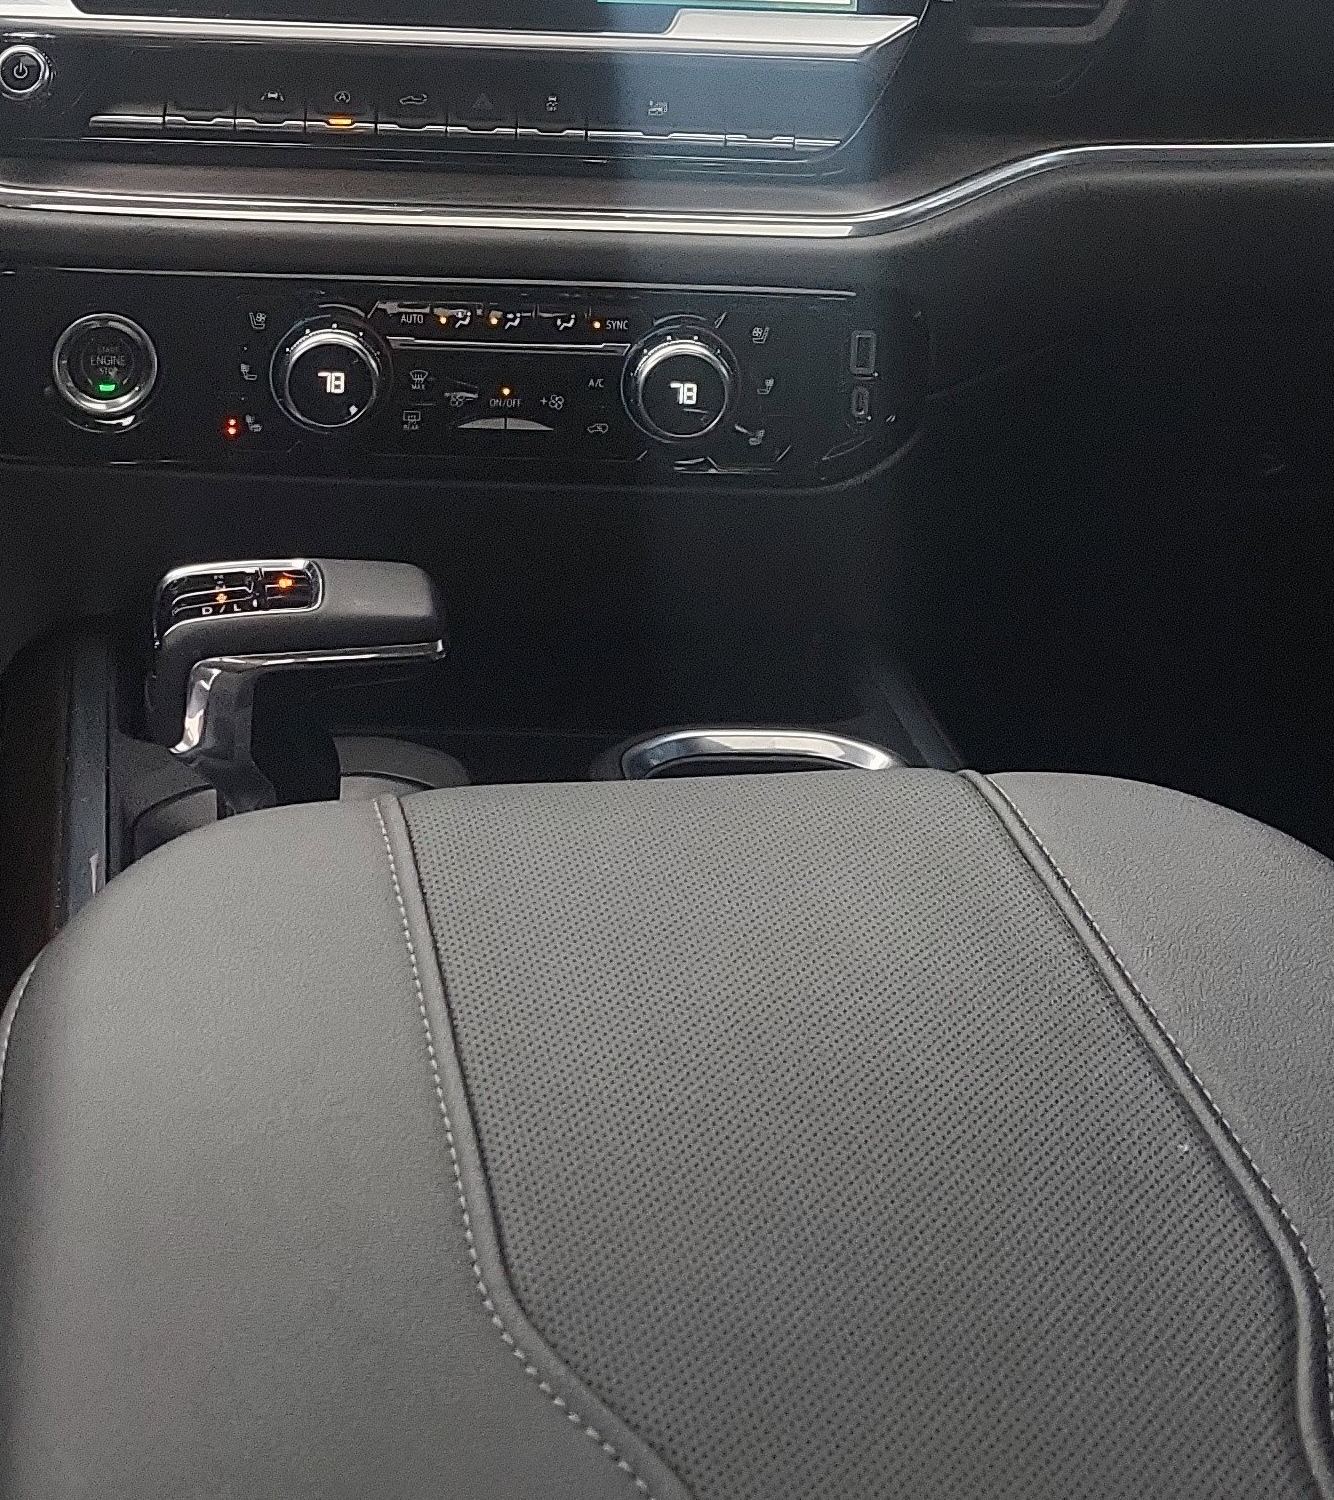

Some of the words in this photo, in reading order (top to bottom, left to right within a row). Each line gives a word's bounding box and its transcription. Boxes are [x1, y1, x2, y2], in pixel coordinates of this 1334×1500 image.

[400, 314, 424, 325] AUTO
[605, 319, 629, 331] SYNC
[90, 355, 126, 367] ENGINE
[317, 371, 345, 394] 78
[588, 378, 604, 388] A/C
[669, 383, 698, 405] 78
[489, 398, 521, 408] ON/OFF
